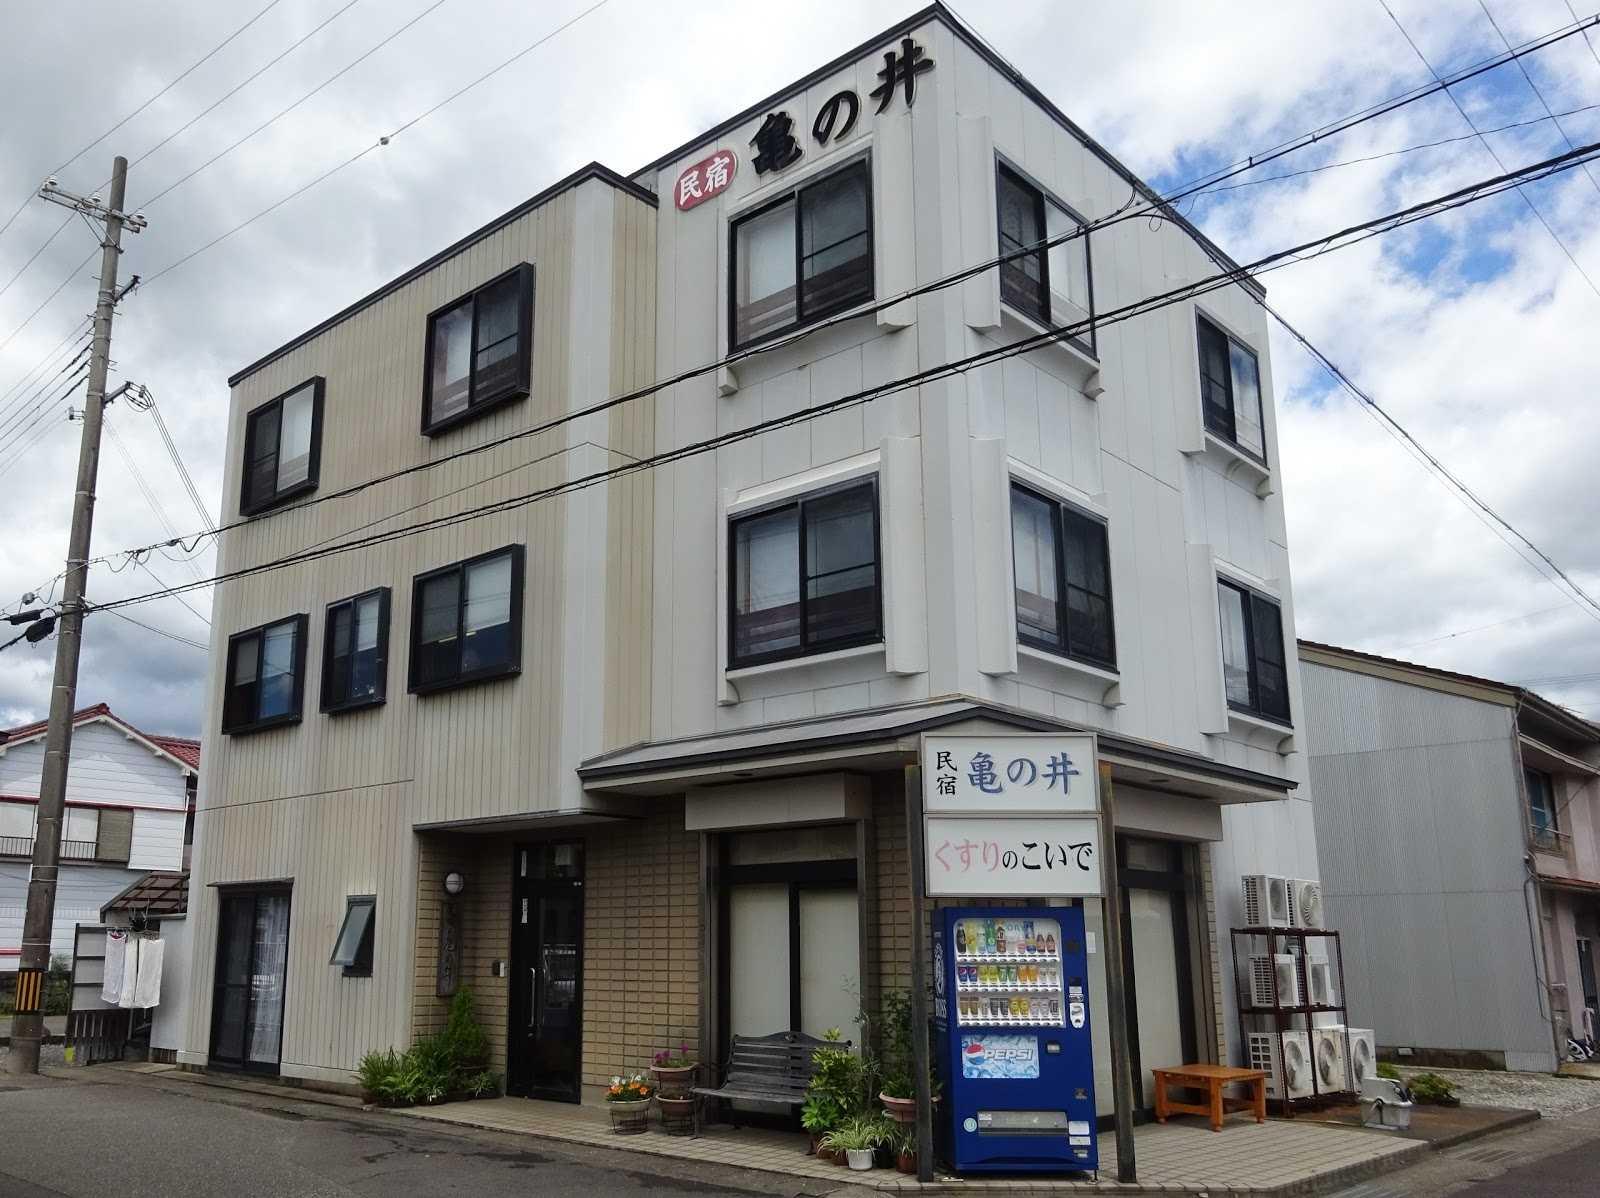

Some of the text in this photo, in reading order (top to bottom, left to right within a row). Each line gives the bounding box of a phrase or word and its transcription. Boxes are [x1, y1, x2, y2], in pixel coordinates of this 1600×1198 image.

[679, 156, 731, 206] 民宿
[936, 751, 958, 796] 民宿
[967, 751, 1080, 795] 亀の井
[935, 839, 1093, 872] くすりのこいで
[984, 1048, 1034, 1061] PEPSI
